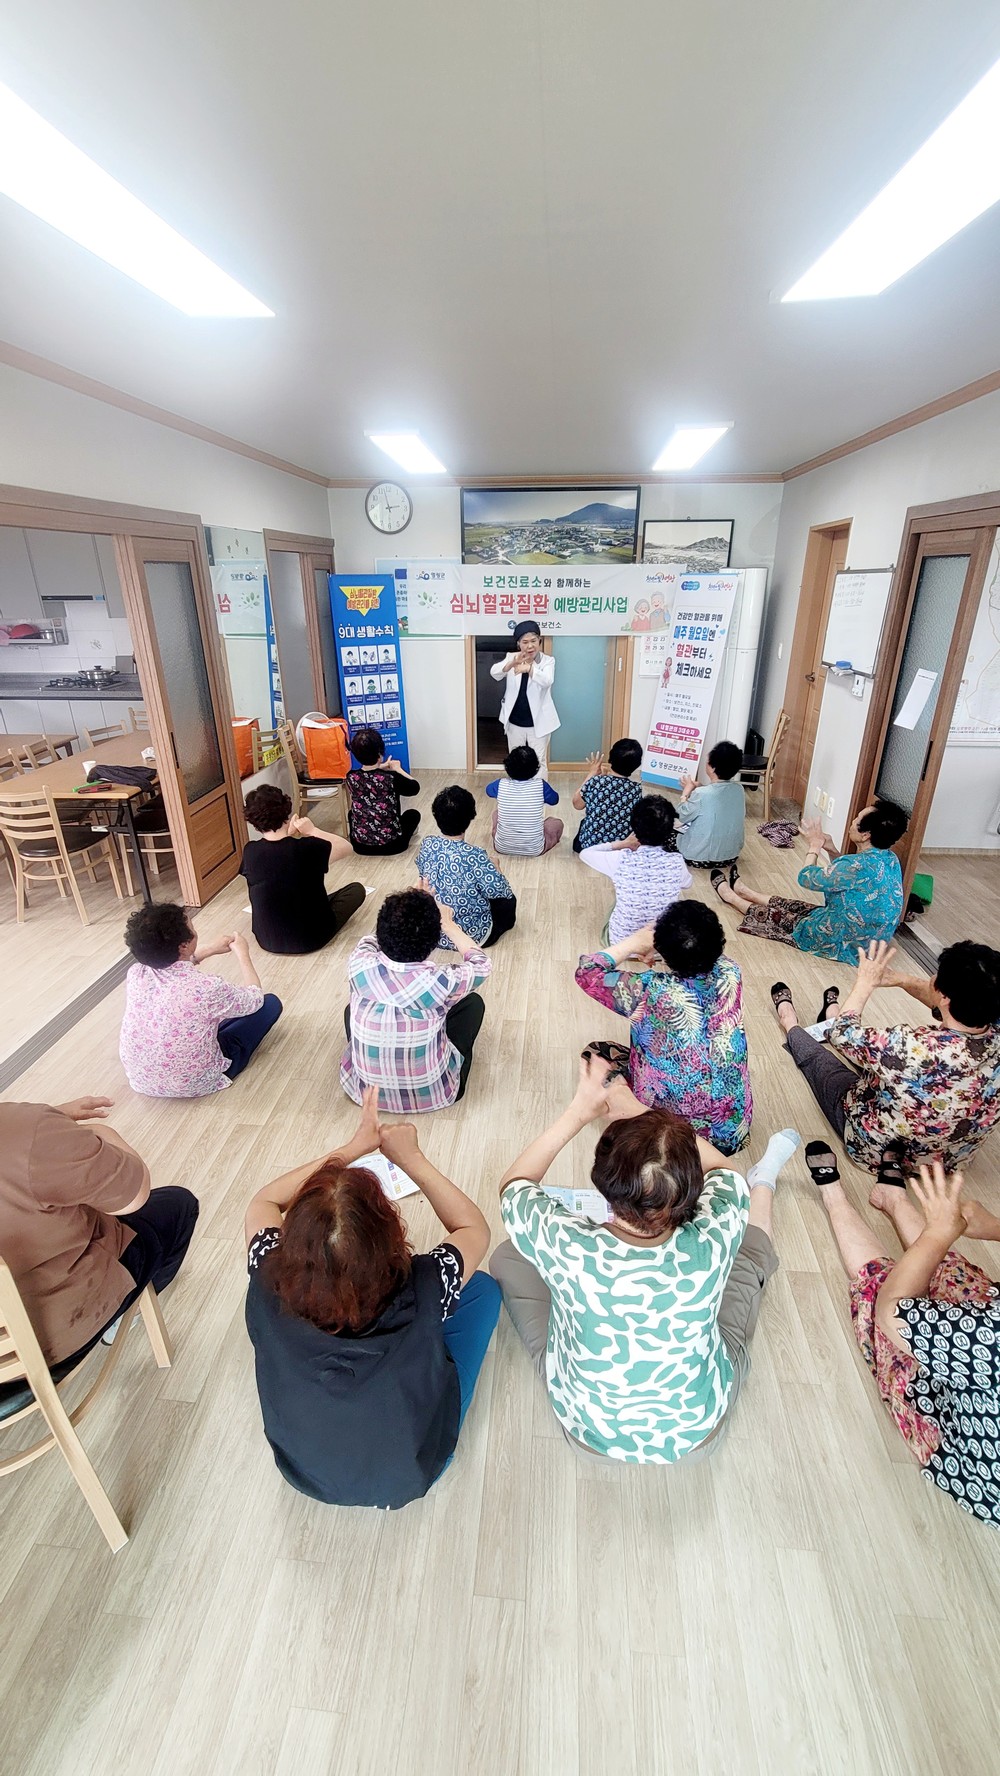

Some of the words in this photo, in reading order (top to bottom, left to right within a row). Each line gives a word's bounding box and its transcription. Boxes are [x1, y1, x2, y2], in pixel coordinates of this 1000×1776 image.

[483, 575, 552, 589] 보건진료소와
[556, 578, 591, 588] 함께하는
[450, 593, 549, 614] 심뇌혈관질환
[554, 596, 628, 613] 예방관리사업
[677, 612, 693, 621] 건강한
[693, 613, 710, 621] 혈관을
[711, 614, 723, 622] 위해
[338, 625, 355, 638] 9대
[356, 625, 394, 638] 생활수칙
[673, 625, 687, 640] 매주
[688, 626, 716, 641] 월요일엔
[675, 643, 708, 659] 혈관부터
[675, 662, 712, 679] 체크하세요
[658, 761, 688, 774] 영광군보건소
